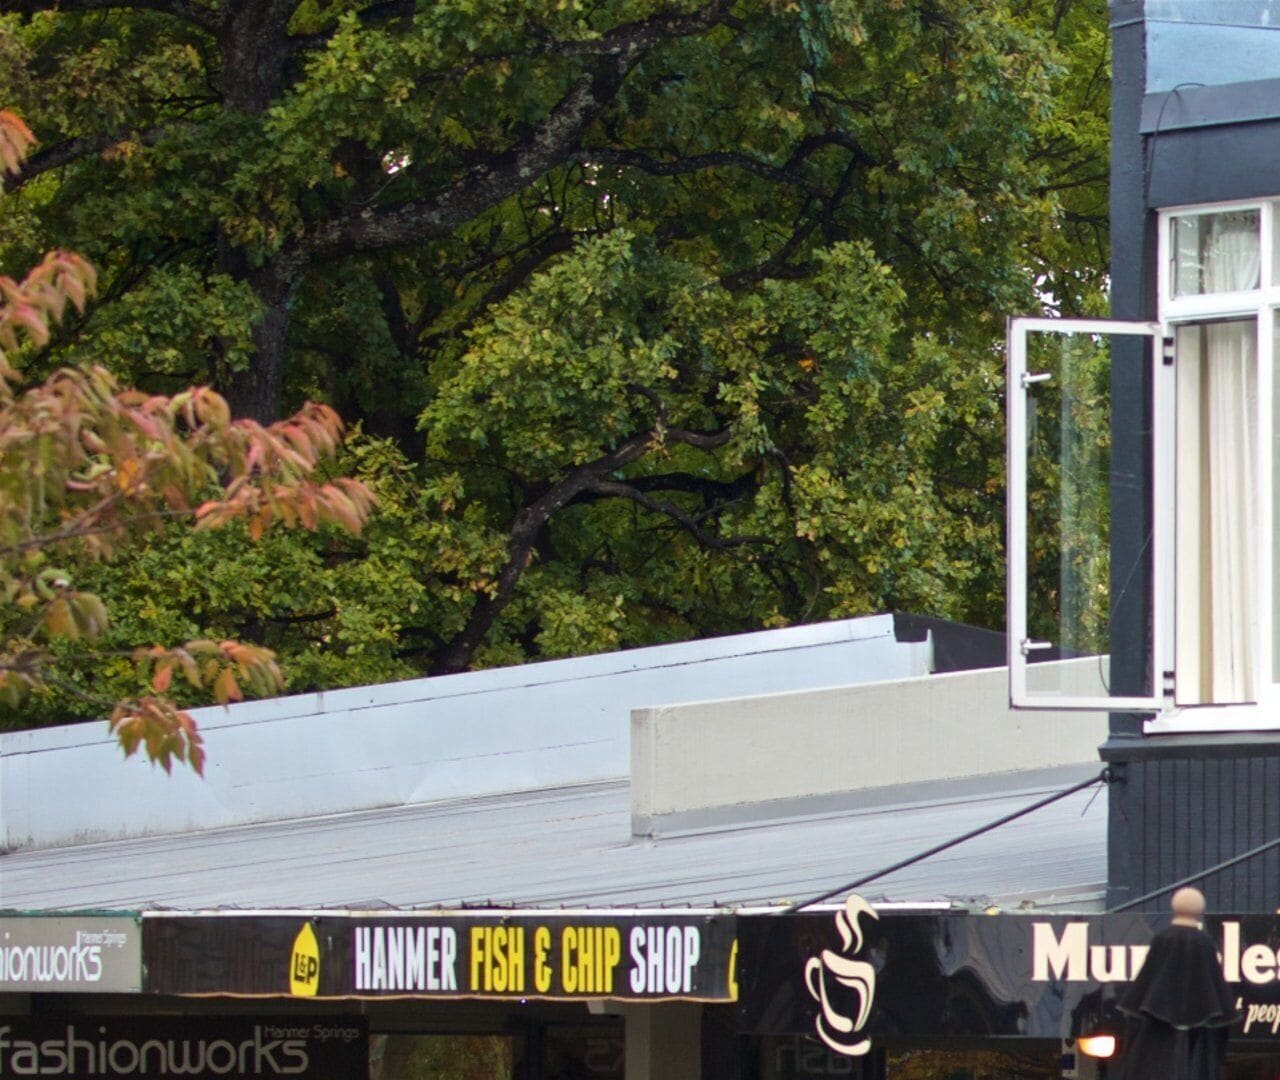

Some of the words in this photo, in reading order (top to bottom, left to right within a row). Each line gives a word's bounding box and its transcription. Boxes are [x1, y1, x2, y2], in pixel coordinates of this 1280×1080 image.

[294, 953, 317, 984] L&P
[355, 926, 457, 991] HANMER
[470, 926, 525, 992] FISH
[534, 926, 552, 992] &
[562, 926, 621, 993] CHIP
[630, 925, 700, 993] SHOP
[0, 1025, 308, 1075] fashionworks
[264, 1025, 311, 1039] Hanmer
[313, 1025, 359, 1042] Springs
